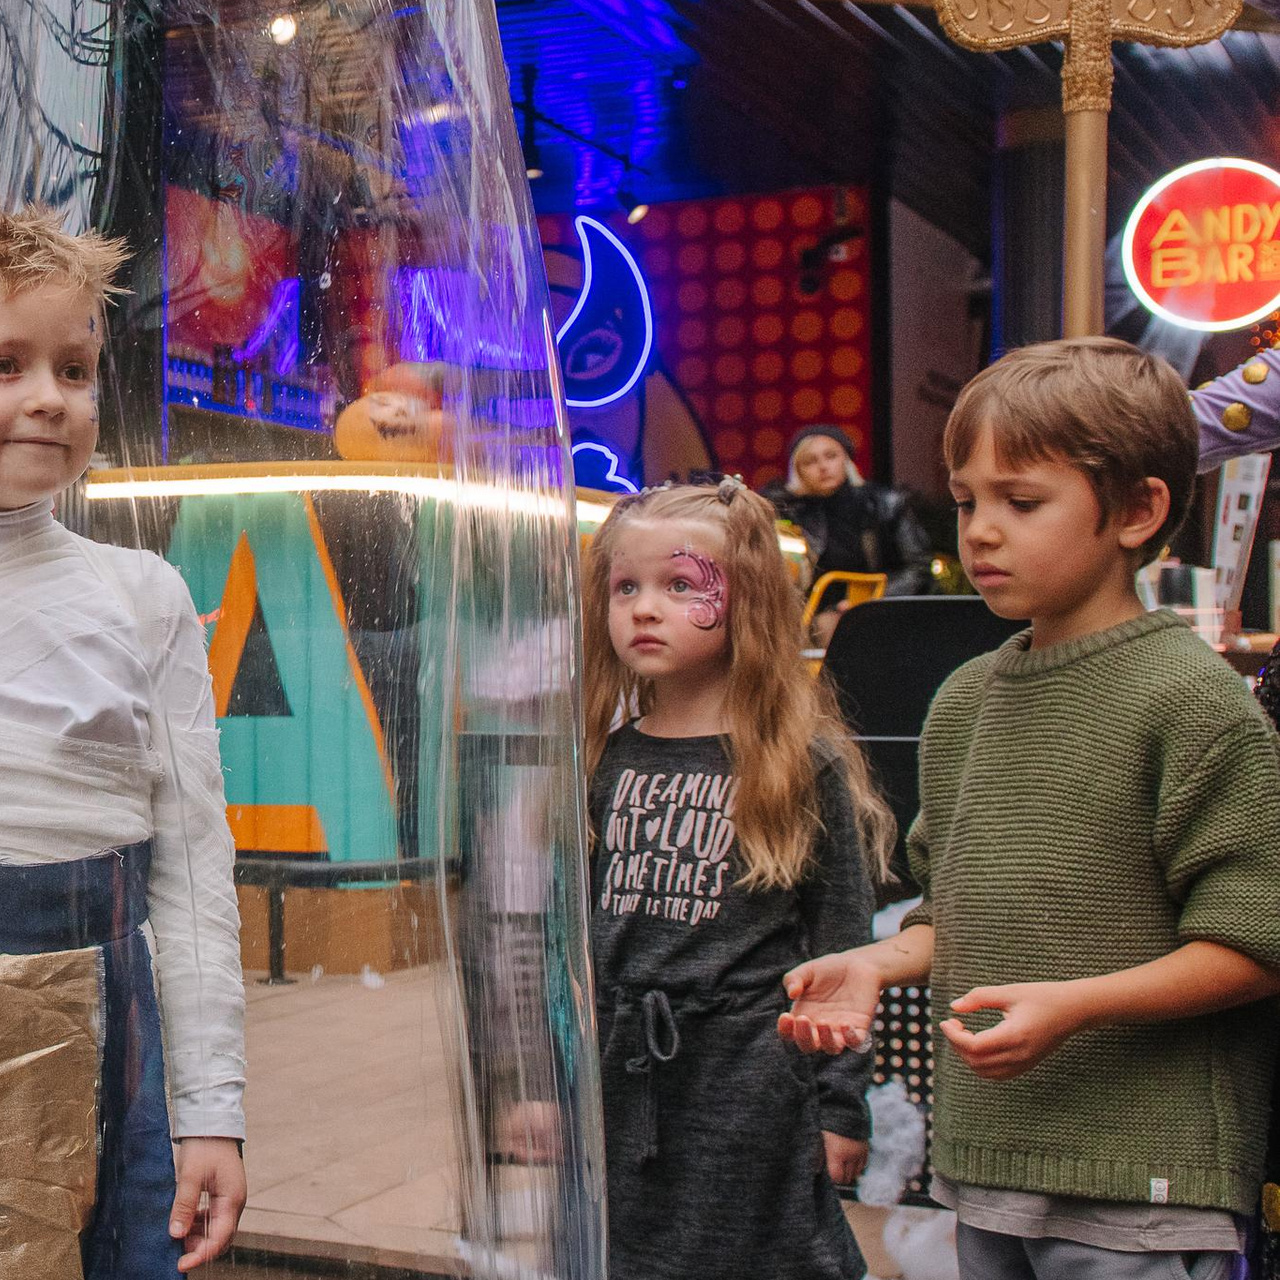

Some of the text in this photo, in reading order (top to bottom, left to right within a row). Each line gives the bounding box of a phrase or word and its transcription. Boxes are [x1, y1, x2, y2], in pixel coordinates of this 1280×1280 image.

[1150, 201, 1280, 248] ANDY
[1151, 243, 1254, 288] BAR
[606, 803, 736, 863] OUT LOUD
[601, 851, 730, 910] SOMETIMES
[645, 896, 662, 916] IS
[664, 895, 691, 922] THE
[689, 898, 722, 927] DAY
